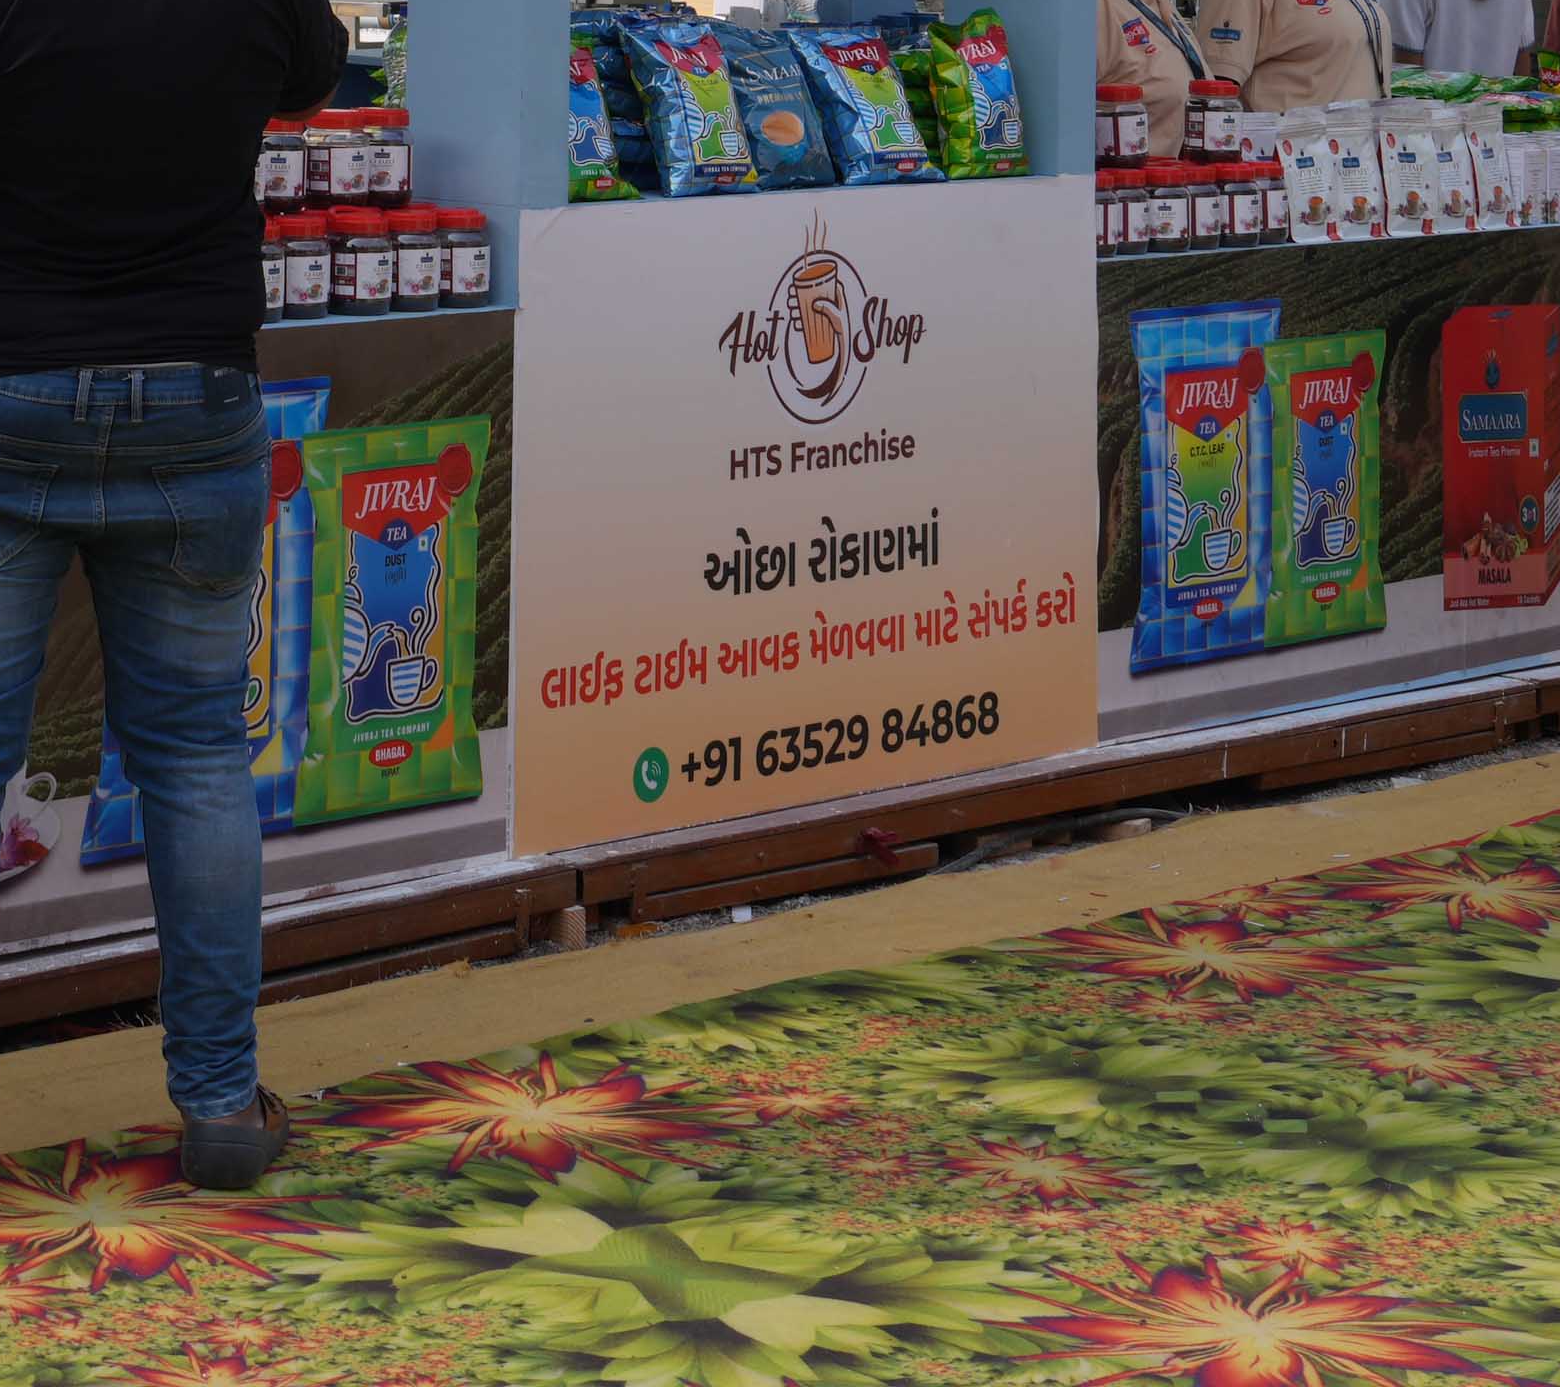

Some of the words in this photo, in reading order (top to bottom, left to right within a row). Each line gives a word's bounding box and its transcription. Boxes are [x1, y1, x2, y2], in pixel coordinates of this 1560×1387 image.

[718, 308, 785, 377] Hot
[852, 295, 927, 365] Shop
[1176, 377, 1239, 415] JIVRAJ
[1299, 376, 1352, 410] JIVRAJ
[1199, 422, 1216, 435] TEA
[1319, 415, 1334, 428] TEA
[729, 444, 782, 481] HTS
[790, 430, 916, 475] Franchise
[1209, 443, 1225, 455] LEAF
[355, 476, 438, 520] JIVRAJ
[386, 525, 408, 542] TEA
[384, 553, 408, 567] DUST
[703, 527, 796, 596] ઓછા
[808, 507, 940, 585] રોકાણમાં
[1478, 568, 1512, 585] MASALA
[634, 638, 708, 694] ટાઈમ
[717, 630, 800, 679] આવક
[809, 609, 906, 665] મેળવવા
[914, 590, 959, 649] માટે
[967, 577, 1028, 640] સંપર્ક
[1035, 572, 1077, 628] કરો
[380, 728, 396, 740] TEA
[396, 722, 431, 738] COMPANY
[680, 735, 743, 788] +91
[755, 715, 869, 777] 63529
[880, 691, 1000, 753] 84868
[374, 745, 407, 763] BHAGAL
